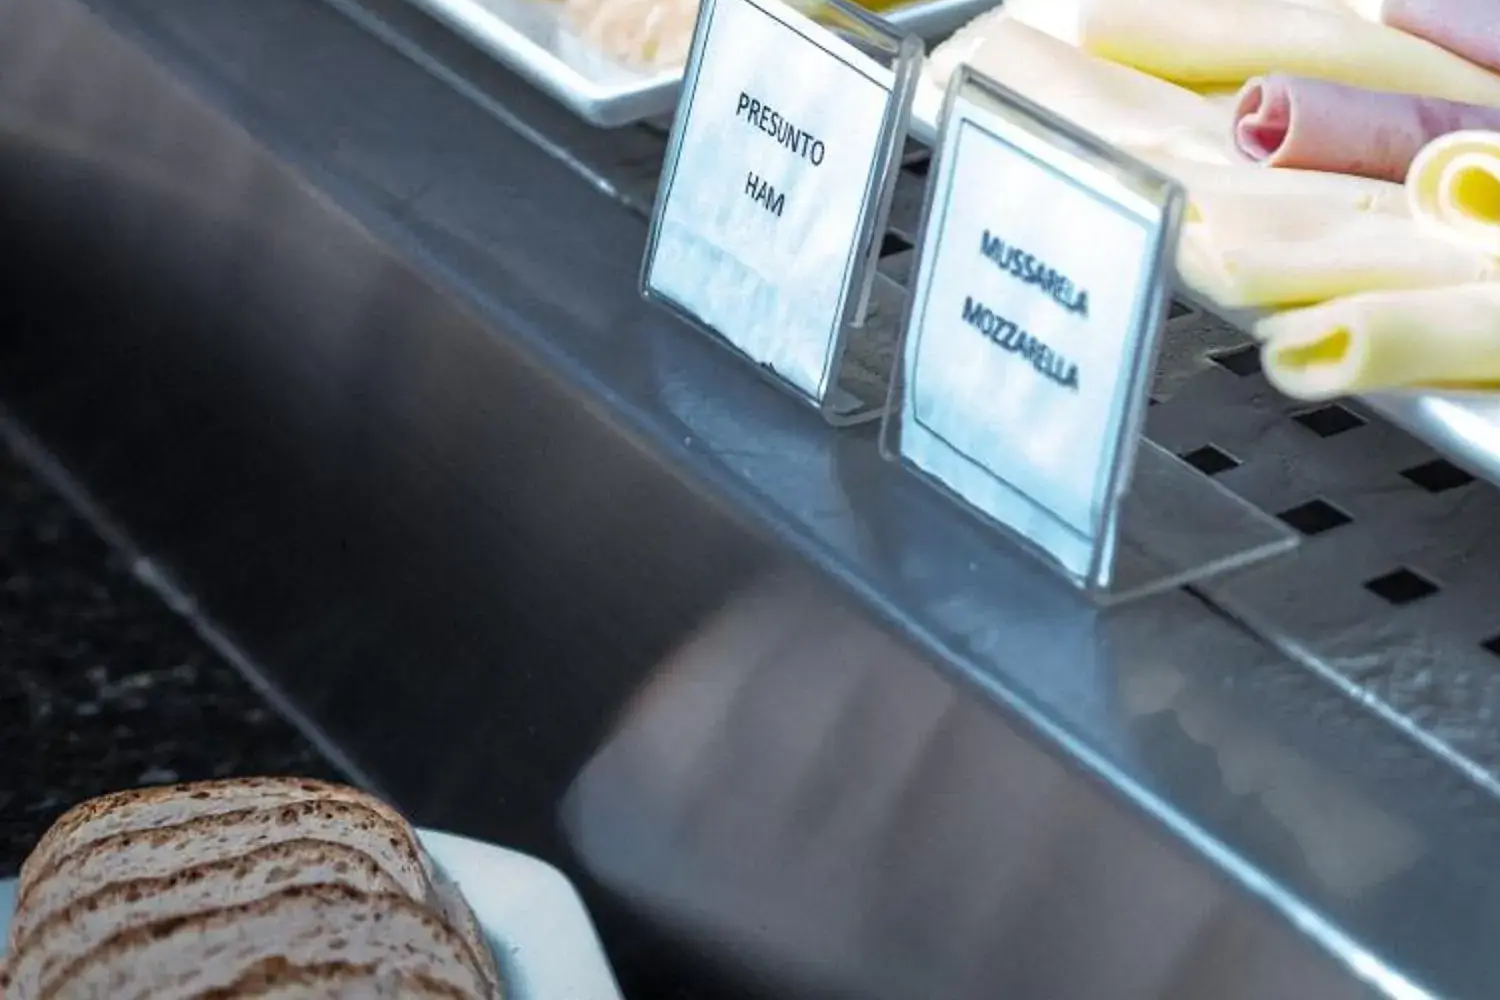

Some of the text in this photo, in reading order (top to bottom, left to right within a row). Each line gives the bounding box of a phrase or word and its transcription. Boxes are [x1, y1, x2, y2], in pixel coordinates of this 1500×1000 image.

[736, 91, 825, 166] PRESUNTO
[745, 170, 785, 217] HAM
[980, 229, 1088, 318] MUSSARELA
[962, 296, 1078, 393] MOZZARELLA
